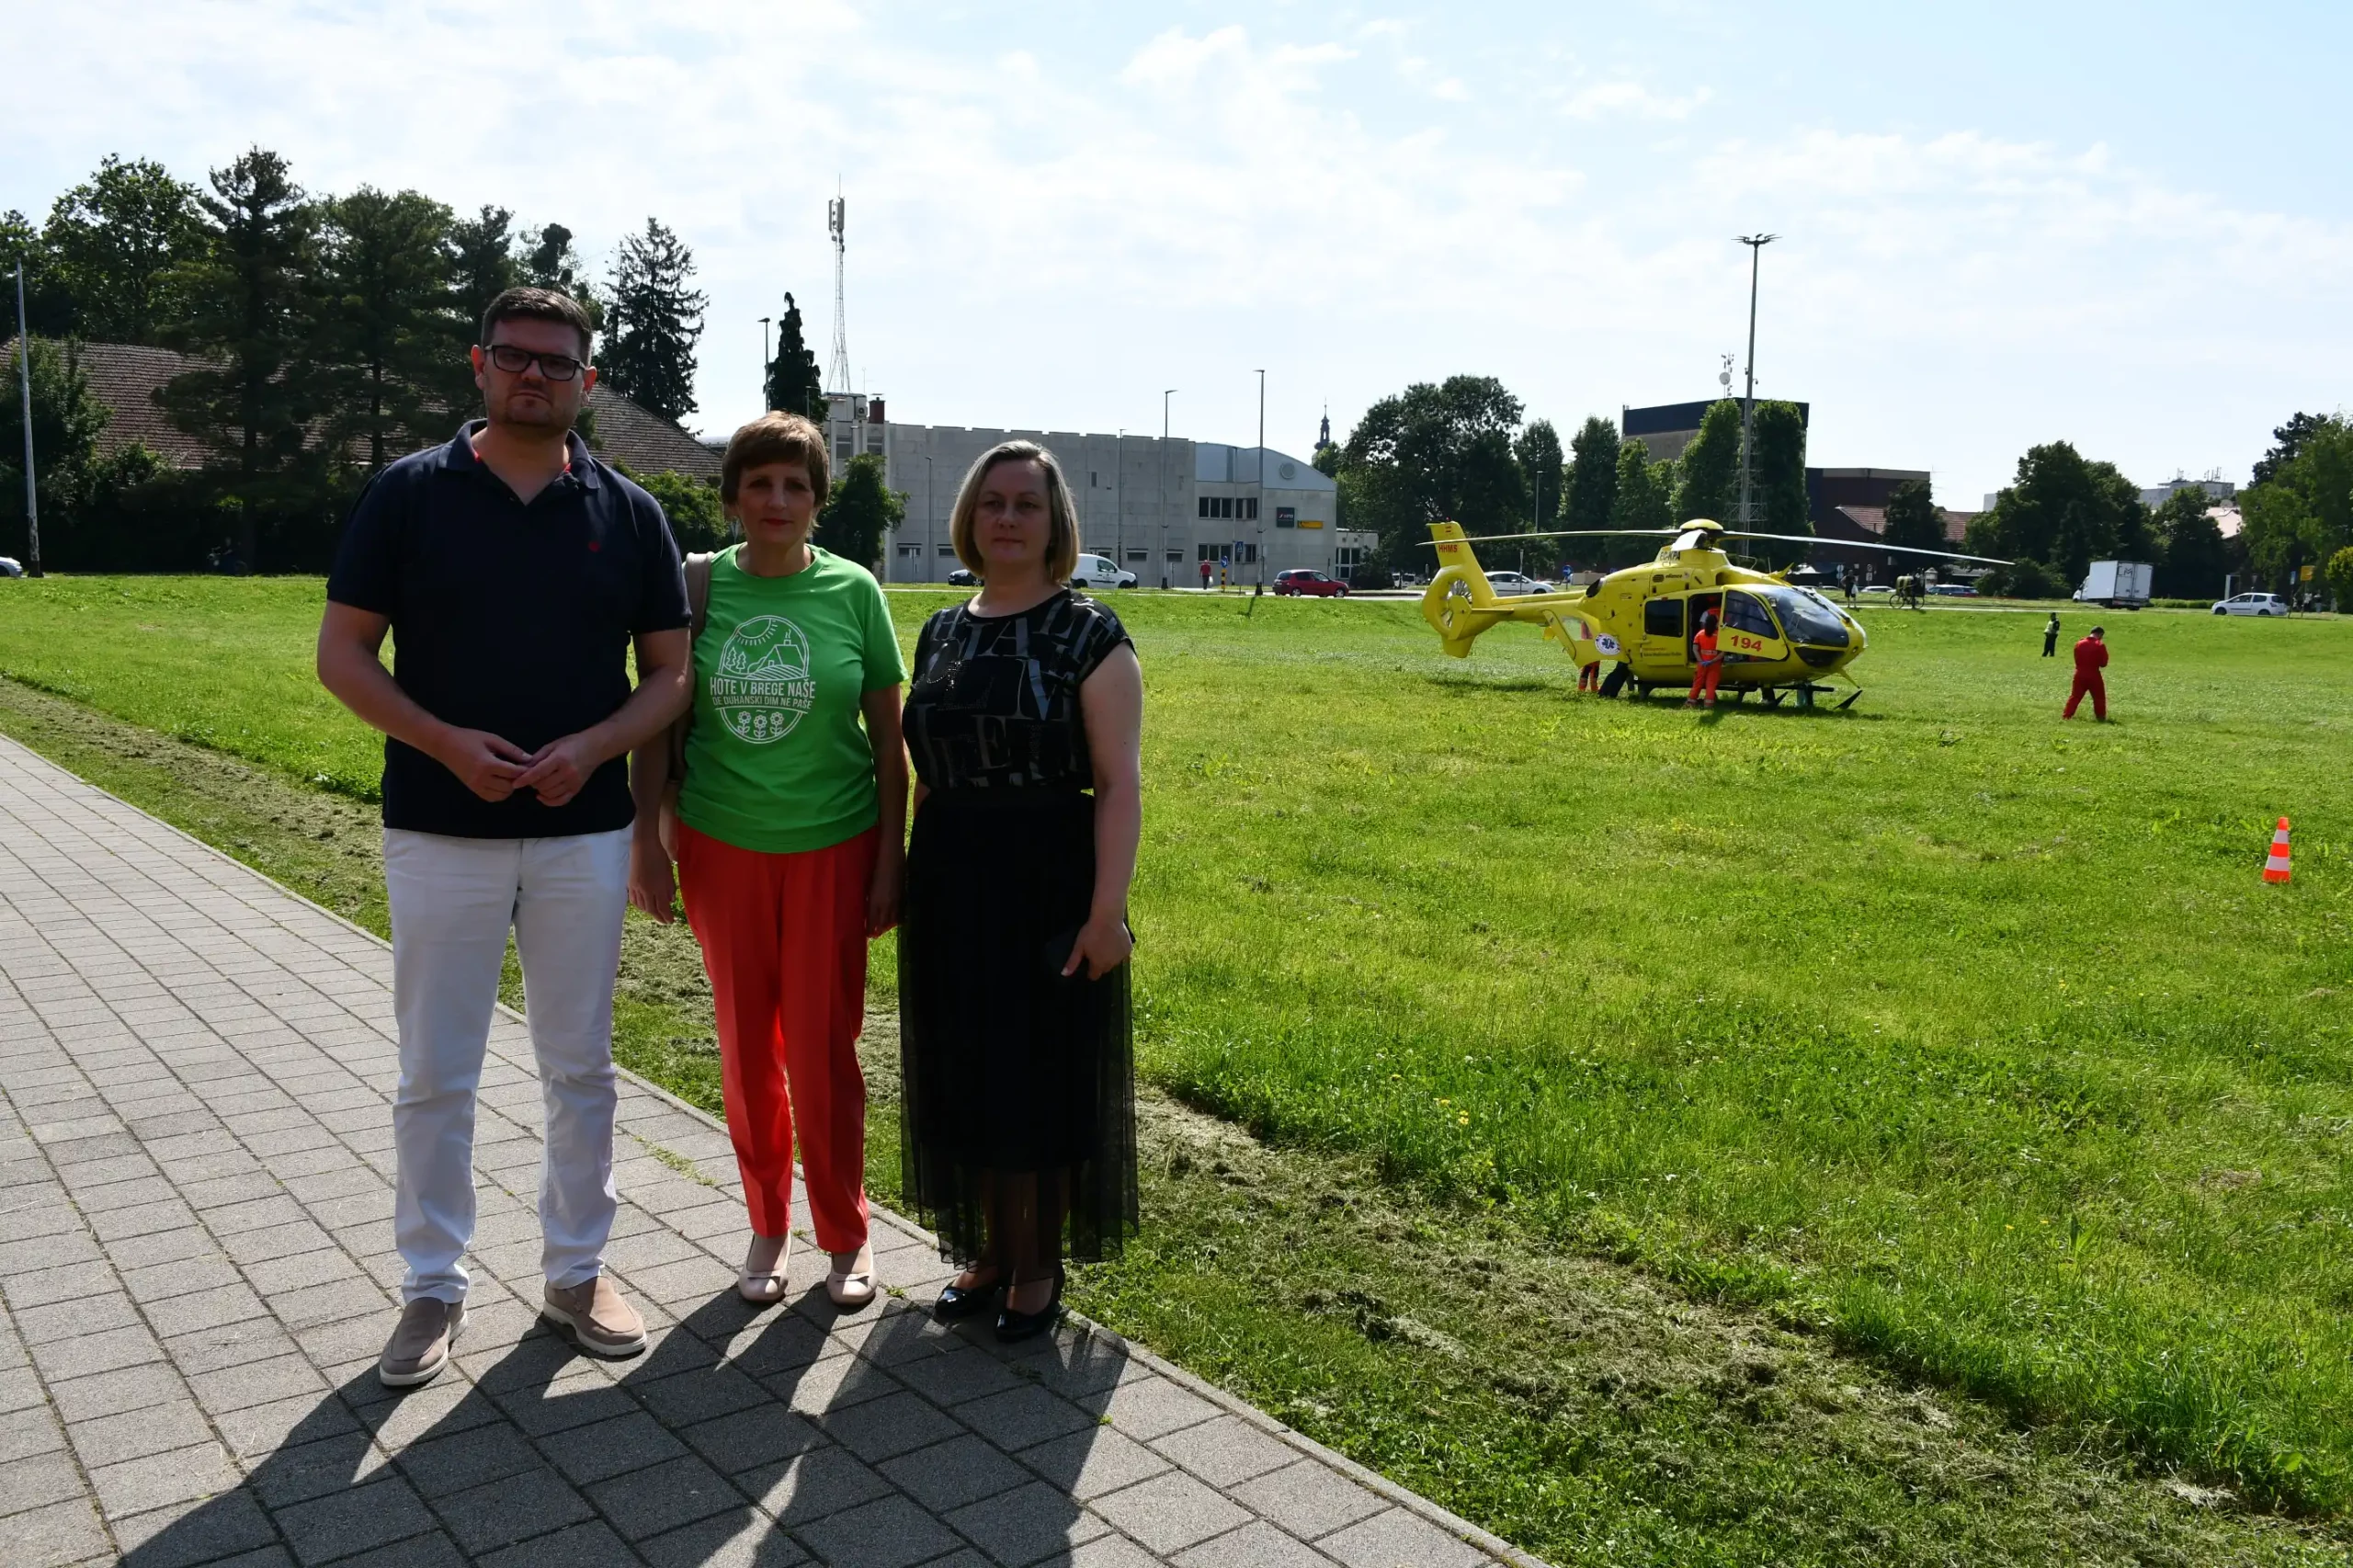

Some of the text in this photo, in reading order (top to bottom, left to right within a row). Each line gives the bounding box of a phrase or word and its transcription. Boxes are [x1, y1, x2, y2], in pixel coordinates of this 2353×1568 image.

[1438, 544, 1458, 552] HHMS
[1730, 635, 1762, 652] 194
[710, 676, 816, 699] HOTE V BREGE NAŠE
[723, 696, 763, 706] DUHANSKI
[764, 696, 779, 706] DIM
[779, 698, 790, 707] NE
[792, 699, 813, 710] PAŠE
